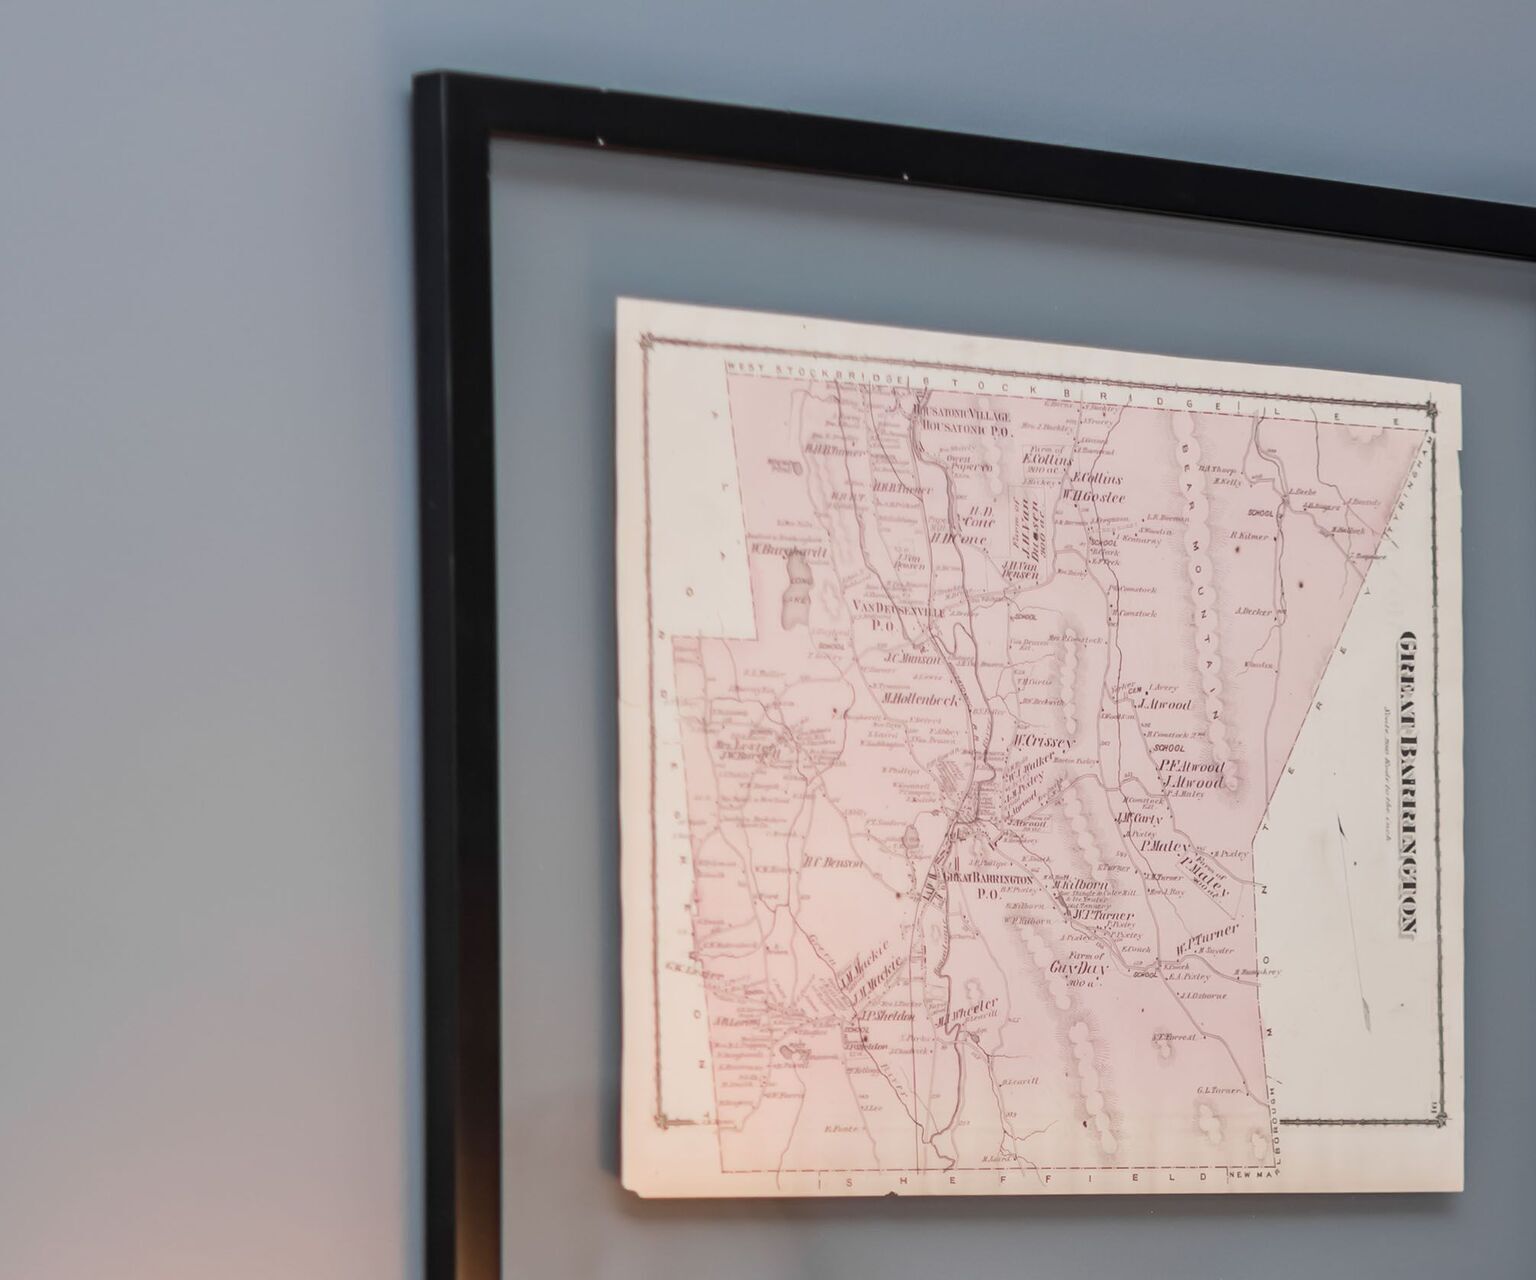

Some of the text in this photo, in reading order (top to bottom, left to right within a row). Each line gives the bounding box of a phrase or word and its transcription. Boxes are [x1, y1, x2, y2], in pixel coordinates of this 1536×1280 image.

[1153, 744, 1186, 753] SCHOOL
[1399, 632, 1419, 935] GREAT BARRINGTON
